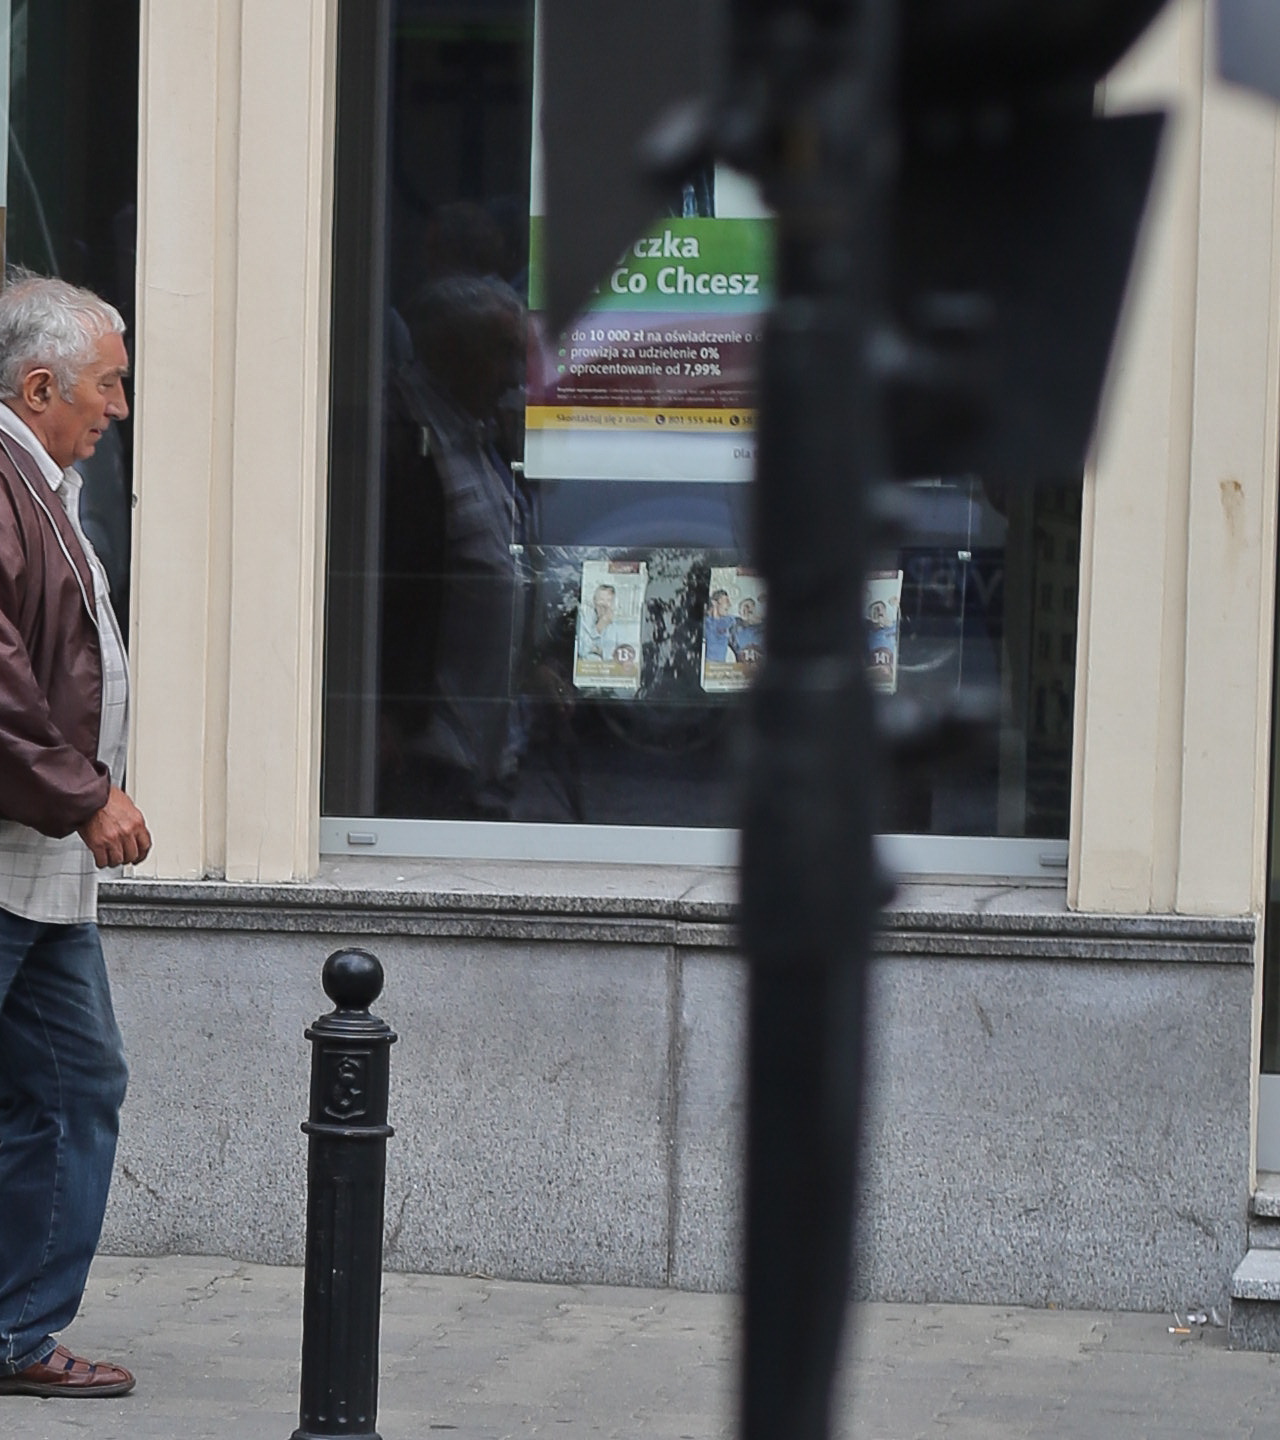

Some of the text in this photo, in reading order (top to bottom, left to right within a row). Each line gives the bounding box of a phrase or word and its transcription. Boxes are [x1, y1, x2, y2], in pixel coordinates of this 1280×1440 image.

[611, 266, 759, 295] Co Chcesz
[572, 330, 586, 342] do
[590, 330, 605, 342] 10
[608, 330, 630, 342] 000
[633, 330, 644, 343] zł
[647, 332, 662, 343] na
[665, 330, 742, 344] oświadczenie
[570, 346, 720, 360] prowizja za udzielenie 0%
[570, 363, 721, 377] oprocentowanie od 7,99%
[733, 448, 752, 459] Dla
